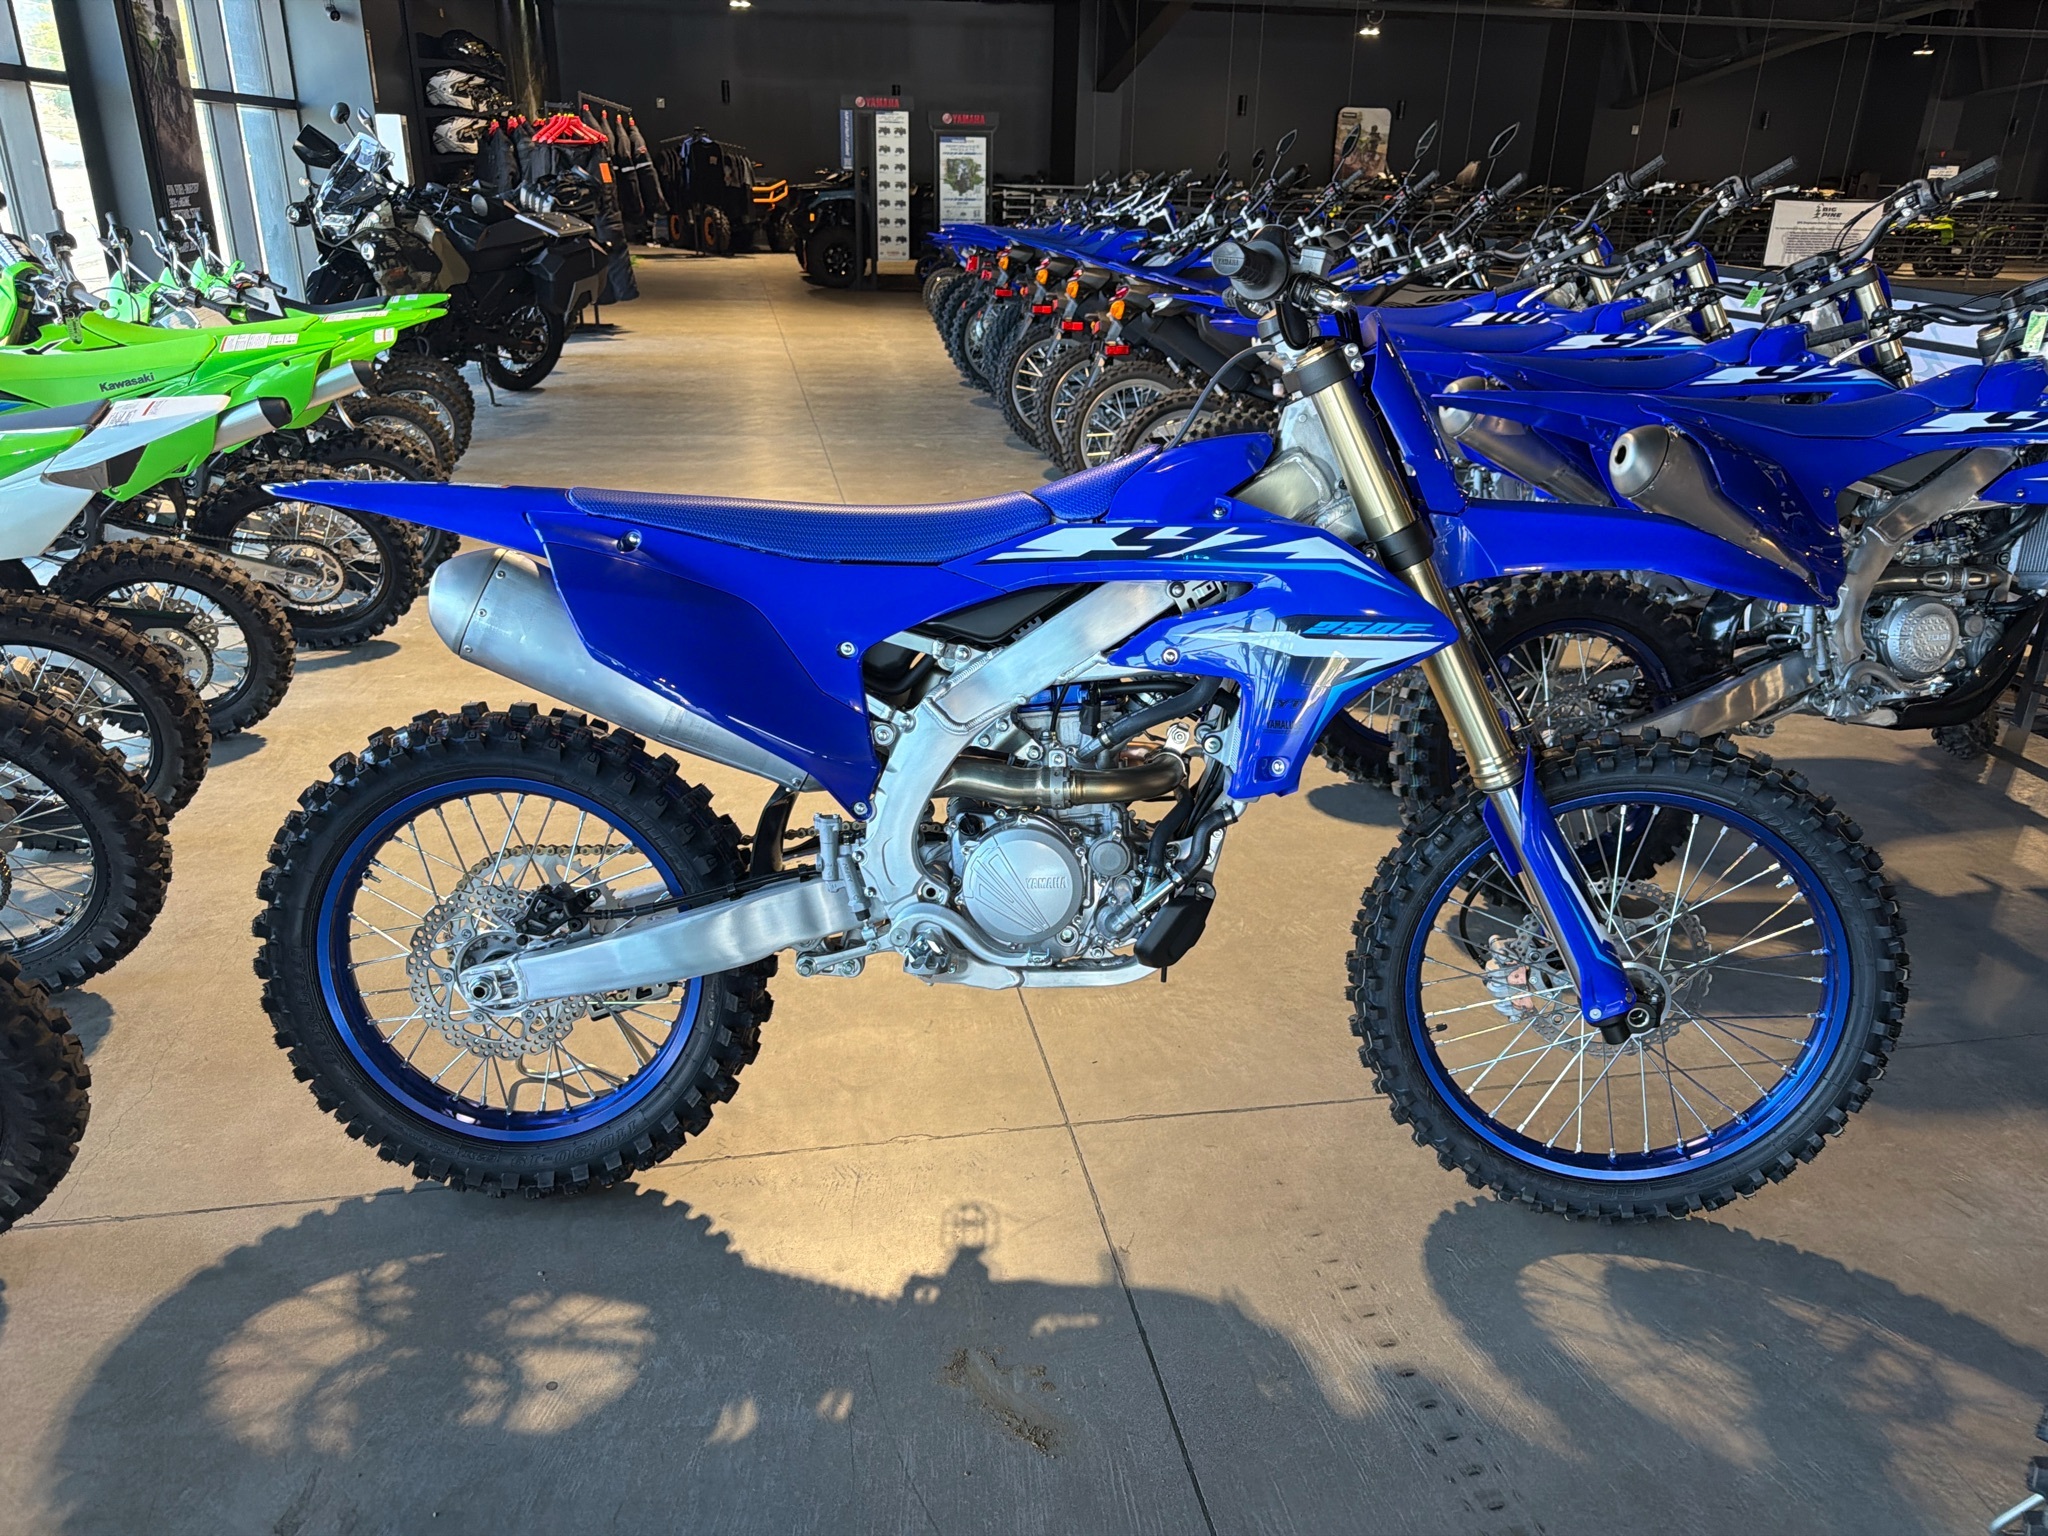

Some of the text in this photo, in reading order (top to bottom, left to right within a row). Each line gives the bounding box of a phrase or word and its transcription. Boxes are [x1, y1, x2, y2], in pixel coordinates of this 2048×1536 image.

[865, 97, 899, 108] YAMAHA
[952, 114, 986, 125] YAMAHA
[99, 372, 155, 392] Kawasaki
[1302, 621, 1434, 635] 250F
[1026, 876, 1067, 889] YAMAHA
